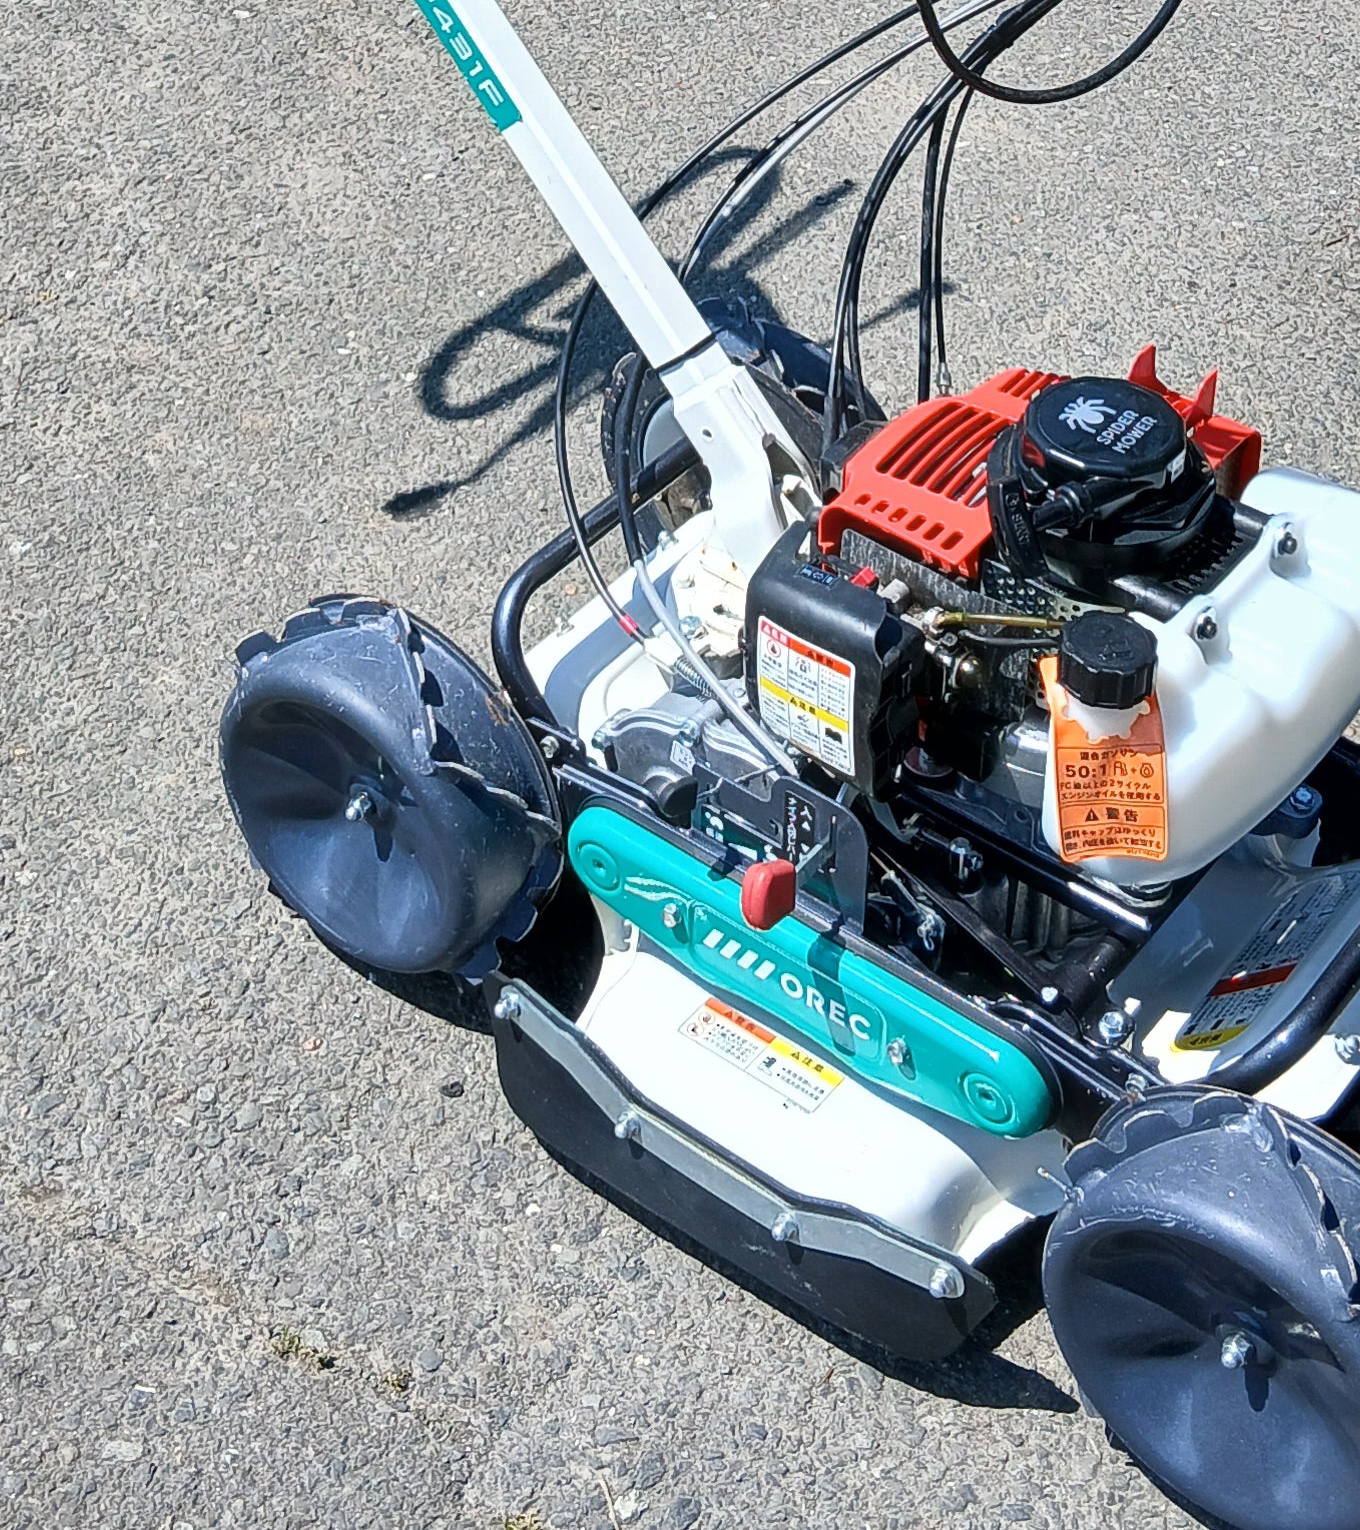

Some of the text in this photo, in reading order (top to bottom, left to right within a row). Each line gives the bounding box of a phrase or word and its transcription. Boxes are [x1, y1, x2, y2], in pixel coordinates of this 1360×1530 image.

[1096, 409, 1140, 446] SPIDER
[1112, 415, 1159, 455] MOWER
[1065, 764, 1107, 779] 50:1
[1105, 805, 1140, 823] 警告
[779, 972, 871, 1042] OREC
